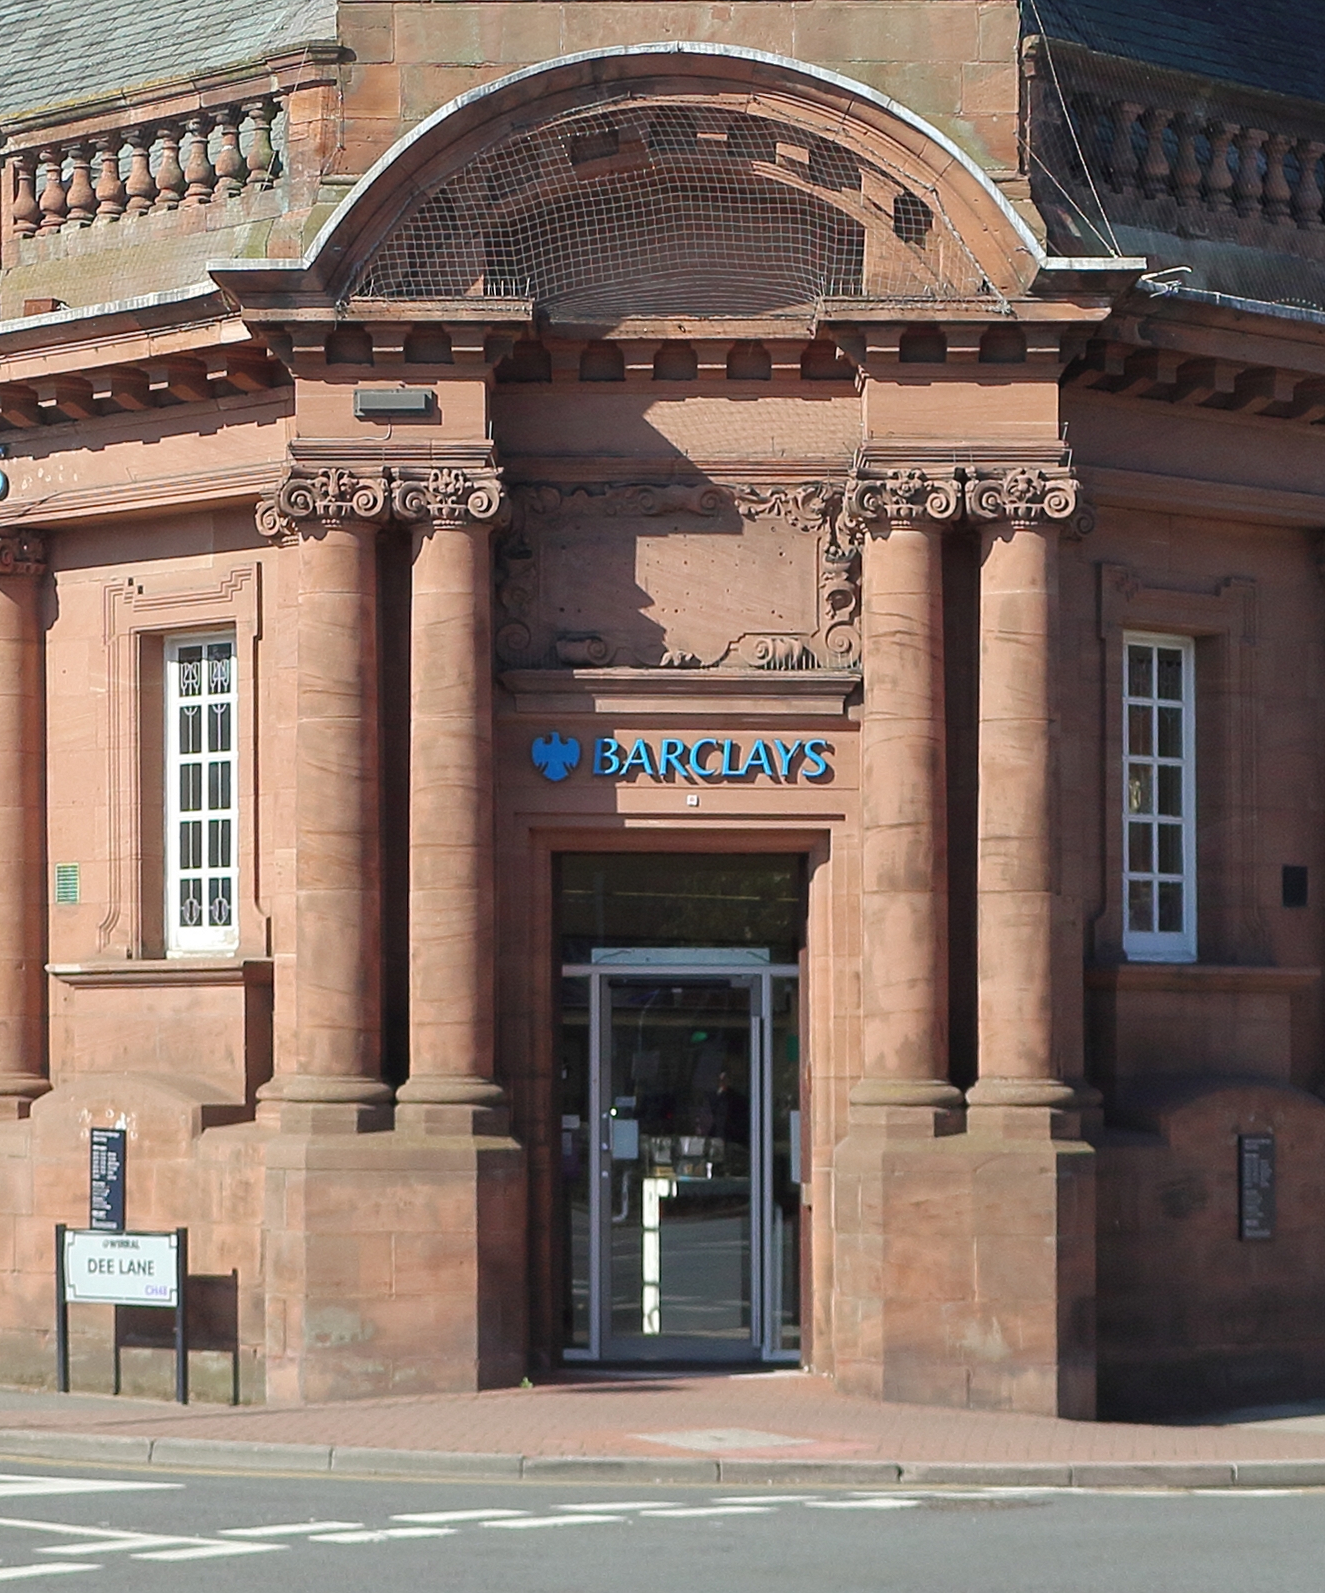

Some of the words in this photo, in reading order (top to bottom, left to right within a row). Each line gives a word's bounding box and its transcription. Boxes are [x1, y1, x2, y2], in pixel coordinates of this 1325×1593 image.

[592, 737, 829, 777] BARCLAYS
[87, 1257, 114, 1275] DEE
[119, 1258, 154, 1276] LANE
